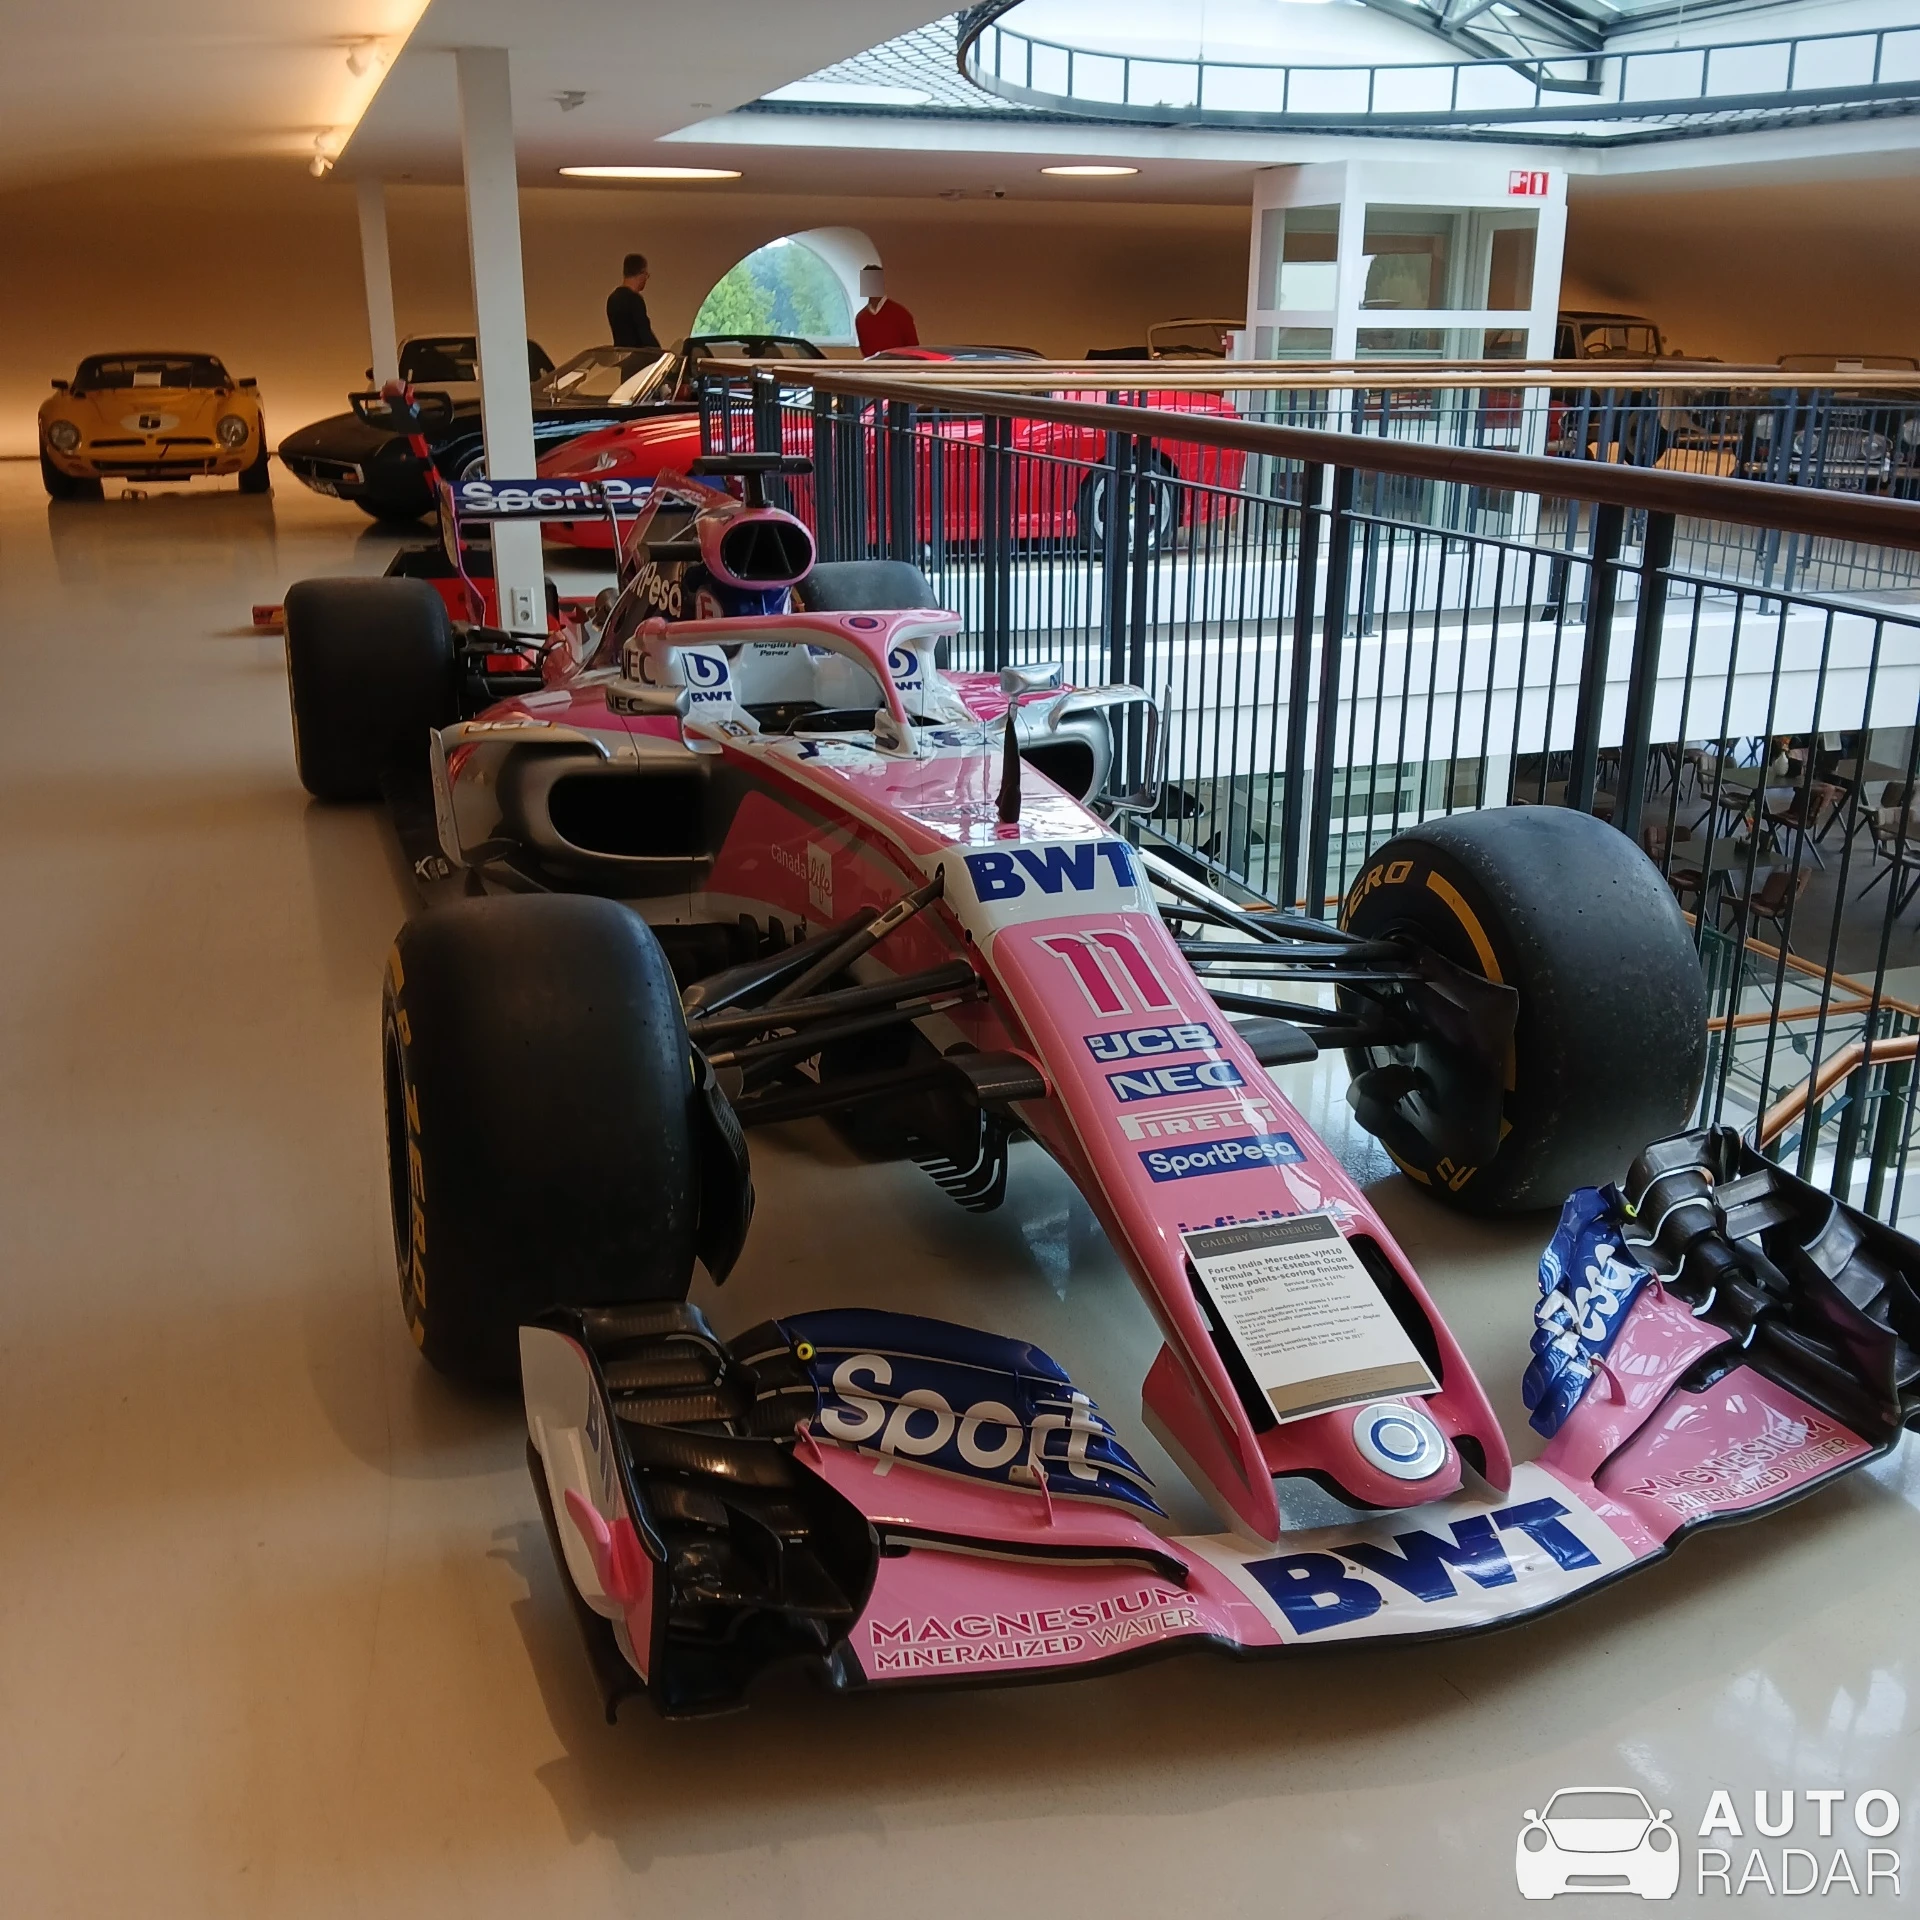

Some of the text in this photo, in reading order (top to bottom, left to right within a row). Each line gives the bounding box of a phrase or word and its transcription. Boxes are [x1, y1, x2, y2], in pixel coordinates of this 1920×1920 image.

[691, 691, 733, 703] BWT
[895, 681, 922, 691] WT
[771, 843, 833, 904] canada life
[963, 842, 1138, 903] BWT
[1030, 929, 1180, 1018] 11
[1088, 1024, 1217, 1059] JCB
[1110, 1061, 1244, 1100] NEC
[1148, 1141, 1298, 1177] SportPesa
[404, 1083, 426, 1309] ZERO
[1199, 1234, 1251, 1248] GALLERY
[1259, 1223, 1323, 1238] AALDERING
[1206, 1246, 1343, 1275] Force India Mercedes VJM10
[1210, 1269, 1254, 1283] Formula
[1321, 1255, 1348, 1265] Ocon
[1219, 1280, 1245, 1290] Nine
[1244, 1267, 1317, 1286] points-scoring
[1316, 1262, 1355, 1274] finishes
[820, 1354, 1103, 1481] Sport
[1623, 1415, 1836, 1498] MAGNESIUM
[1663, 1438, 1860, 1515] MINERALIZED WATER
[1241, 1496, 1602, 1635] BWT
[868, 1586, 1199, 1648] MAGNESIUM
[873, 1608, 1203, 1671] MINERALIZED WATER
